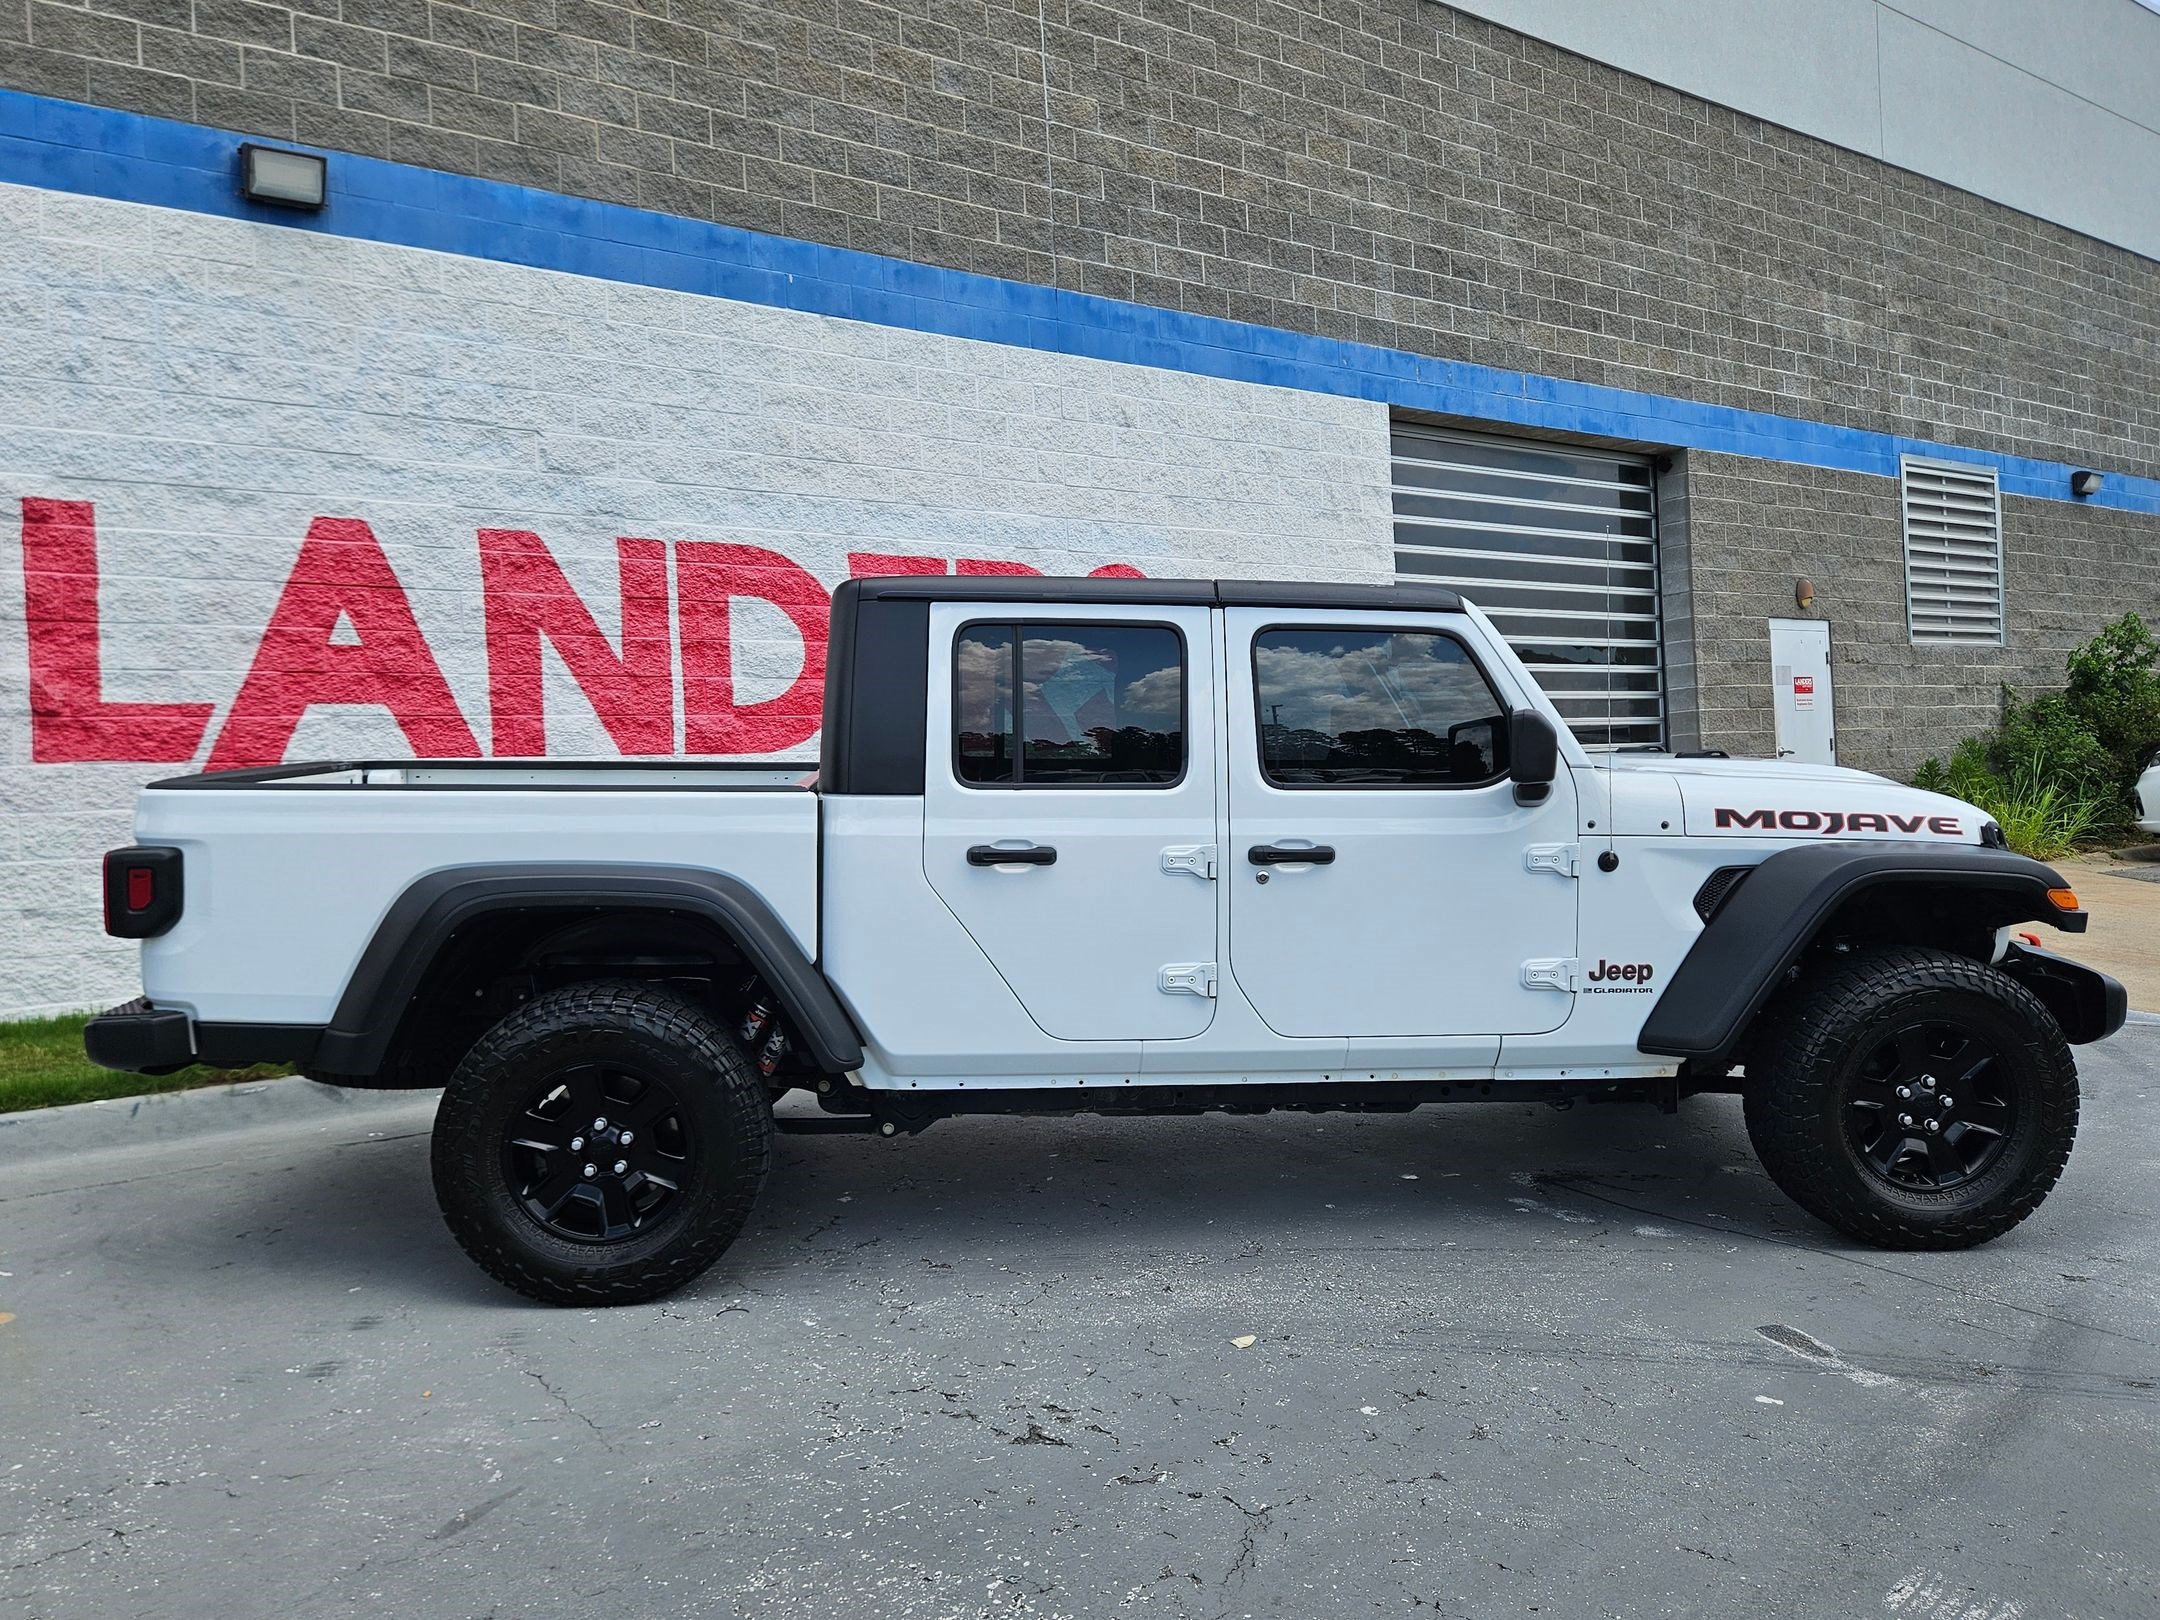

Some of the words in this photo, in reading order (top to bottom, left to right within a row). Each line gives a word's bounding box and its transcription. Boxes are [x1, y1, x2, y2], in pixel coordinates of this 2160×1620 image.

[22, 497, 1148, 773] LAND
[1714, 808, 1963, 835] MOJAVE
[1588, 959, 1654, 985] Jeep
